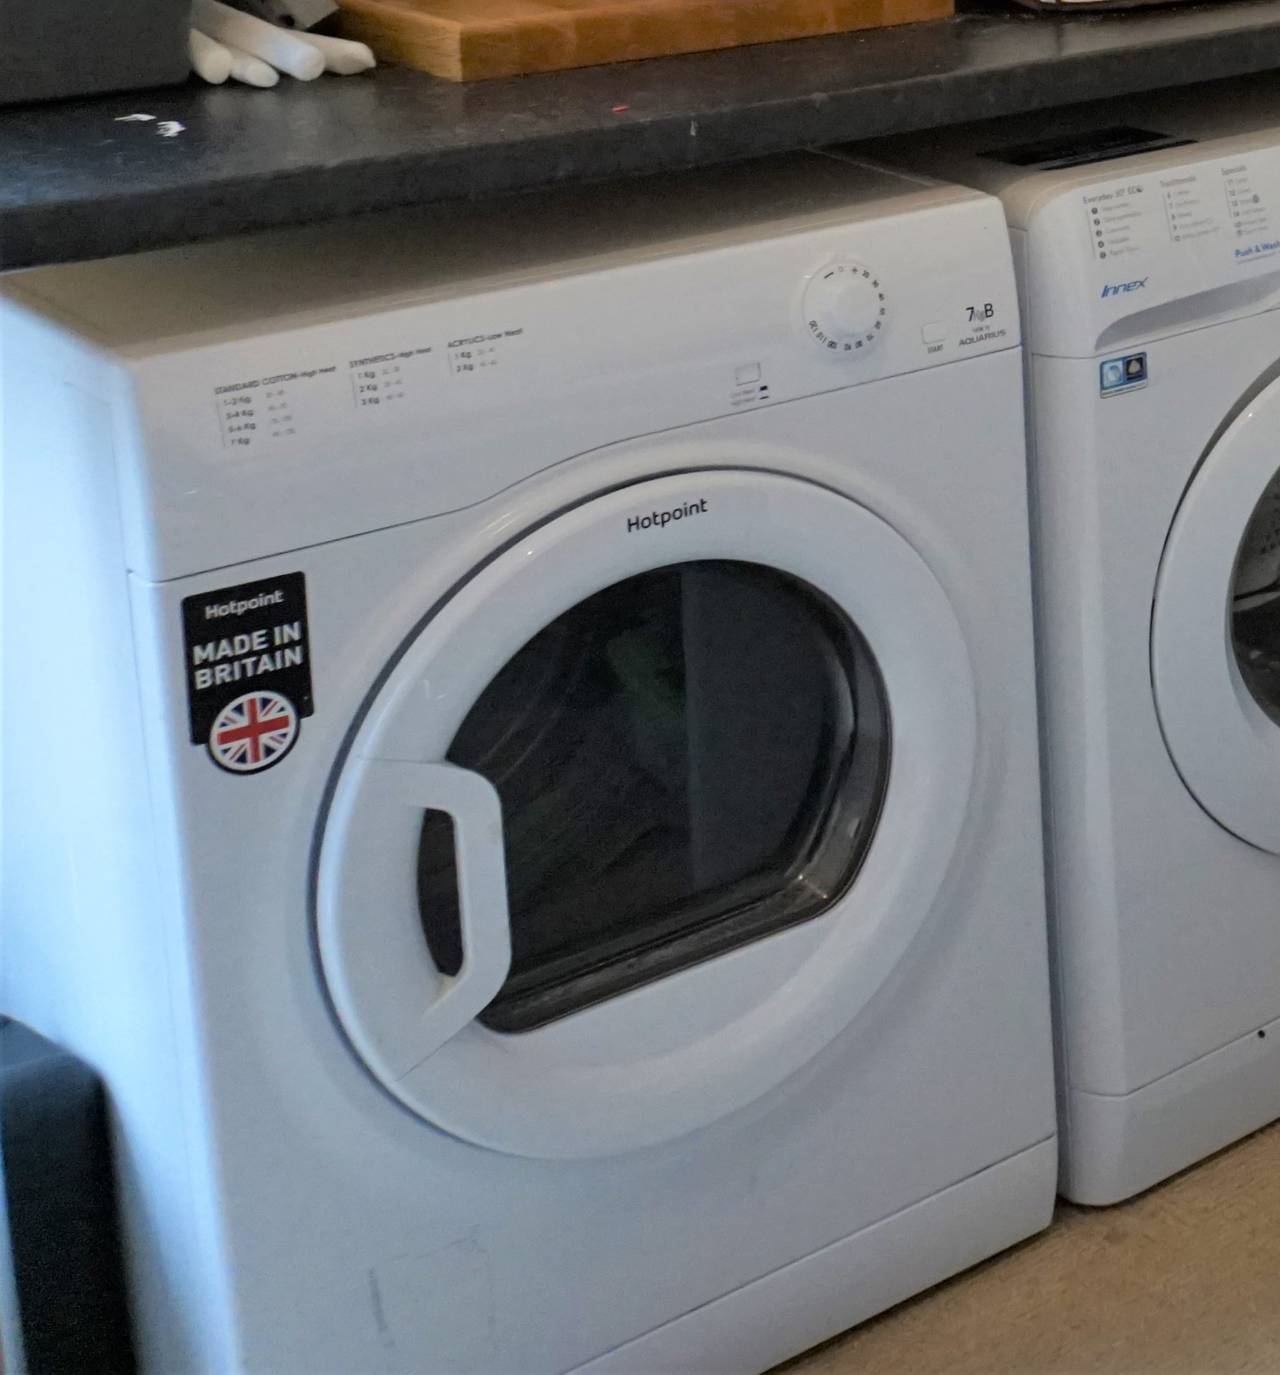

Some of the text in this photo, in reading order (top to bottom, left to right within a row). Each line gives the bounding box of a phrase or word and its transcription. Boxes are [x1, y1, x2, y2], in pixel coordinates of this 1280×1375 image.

[959, 329, 1006, 346] AQUARIUS
[627, 498, 708, 533] Hotpoint
[204, 590, 285, 620] Hotpoint
[193, 621, 302, 666] MADE IN
[194, 645, 304, 690] BRITAIN
